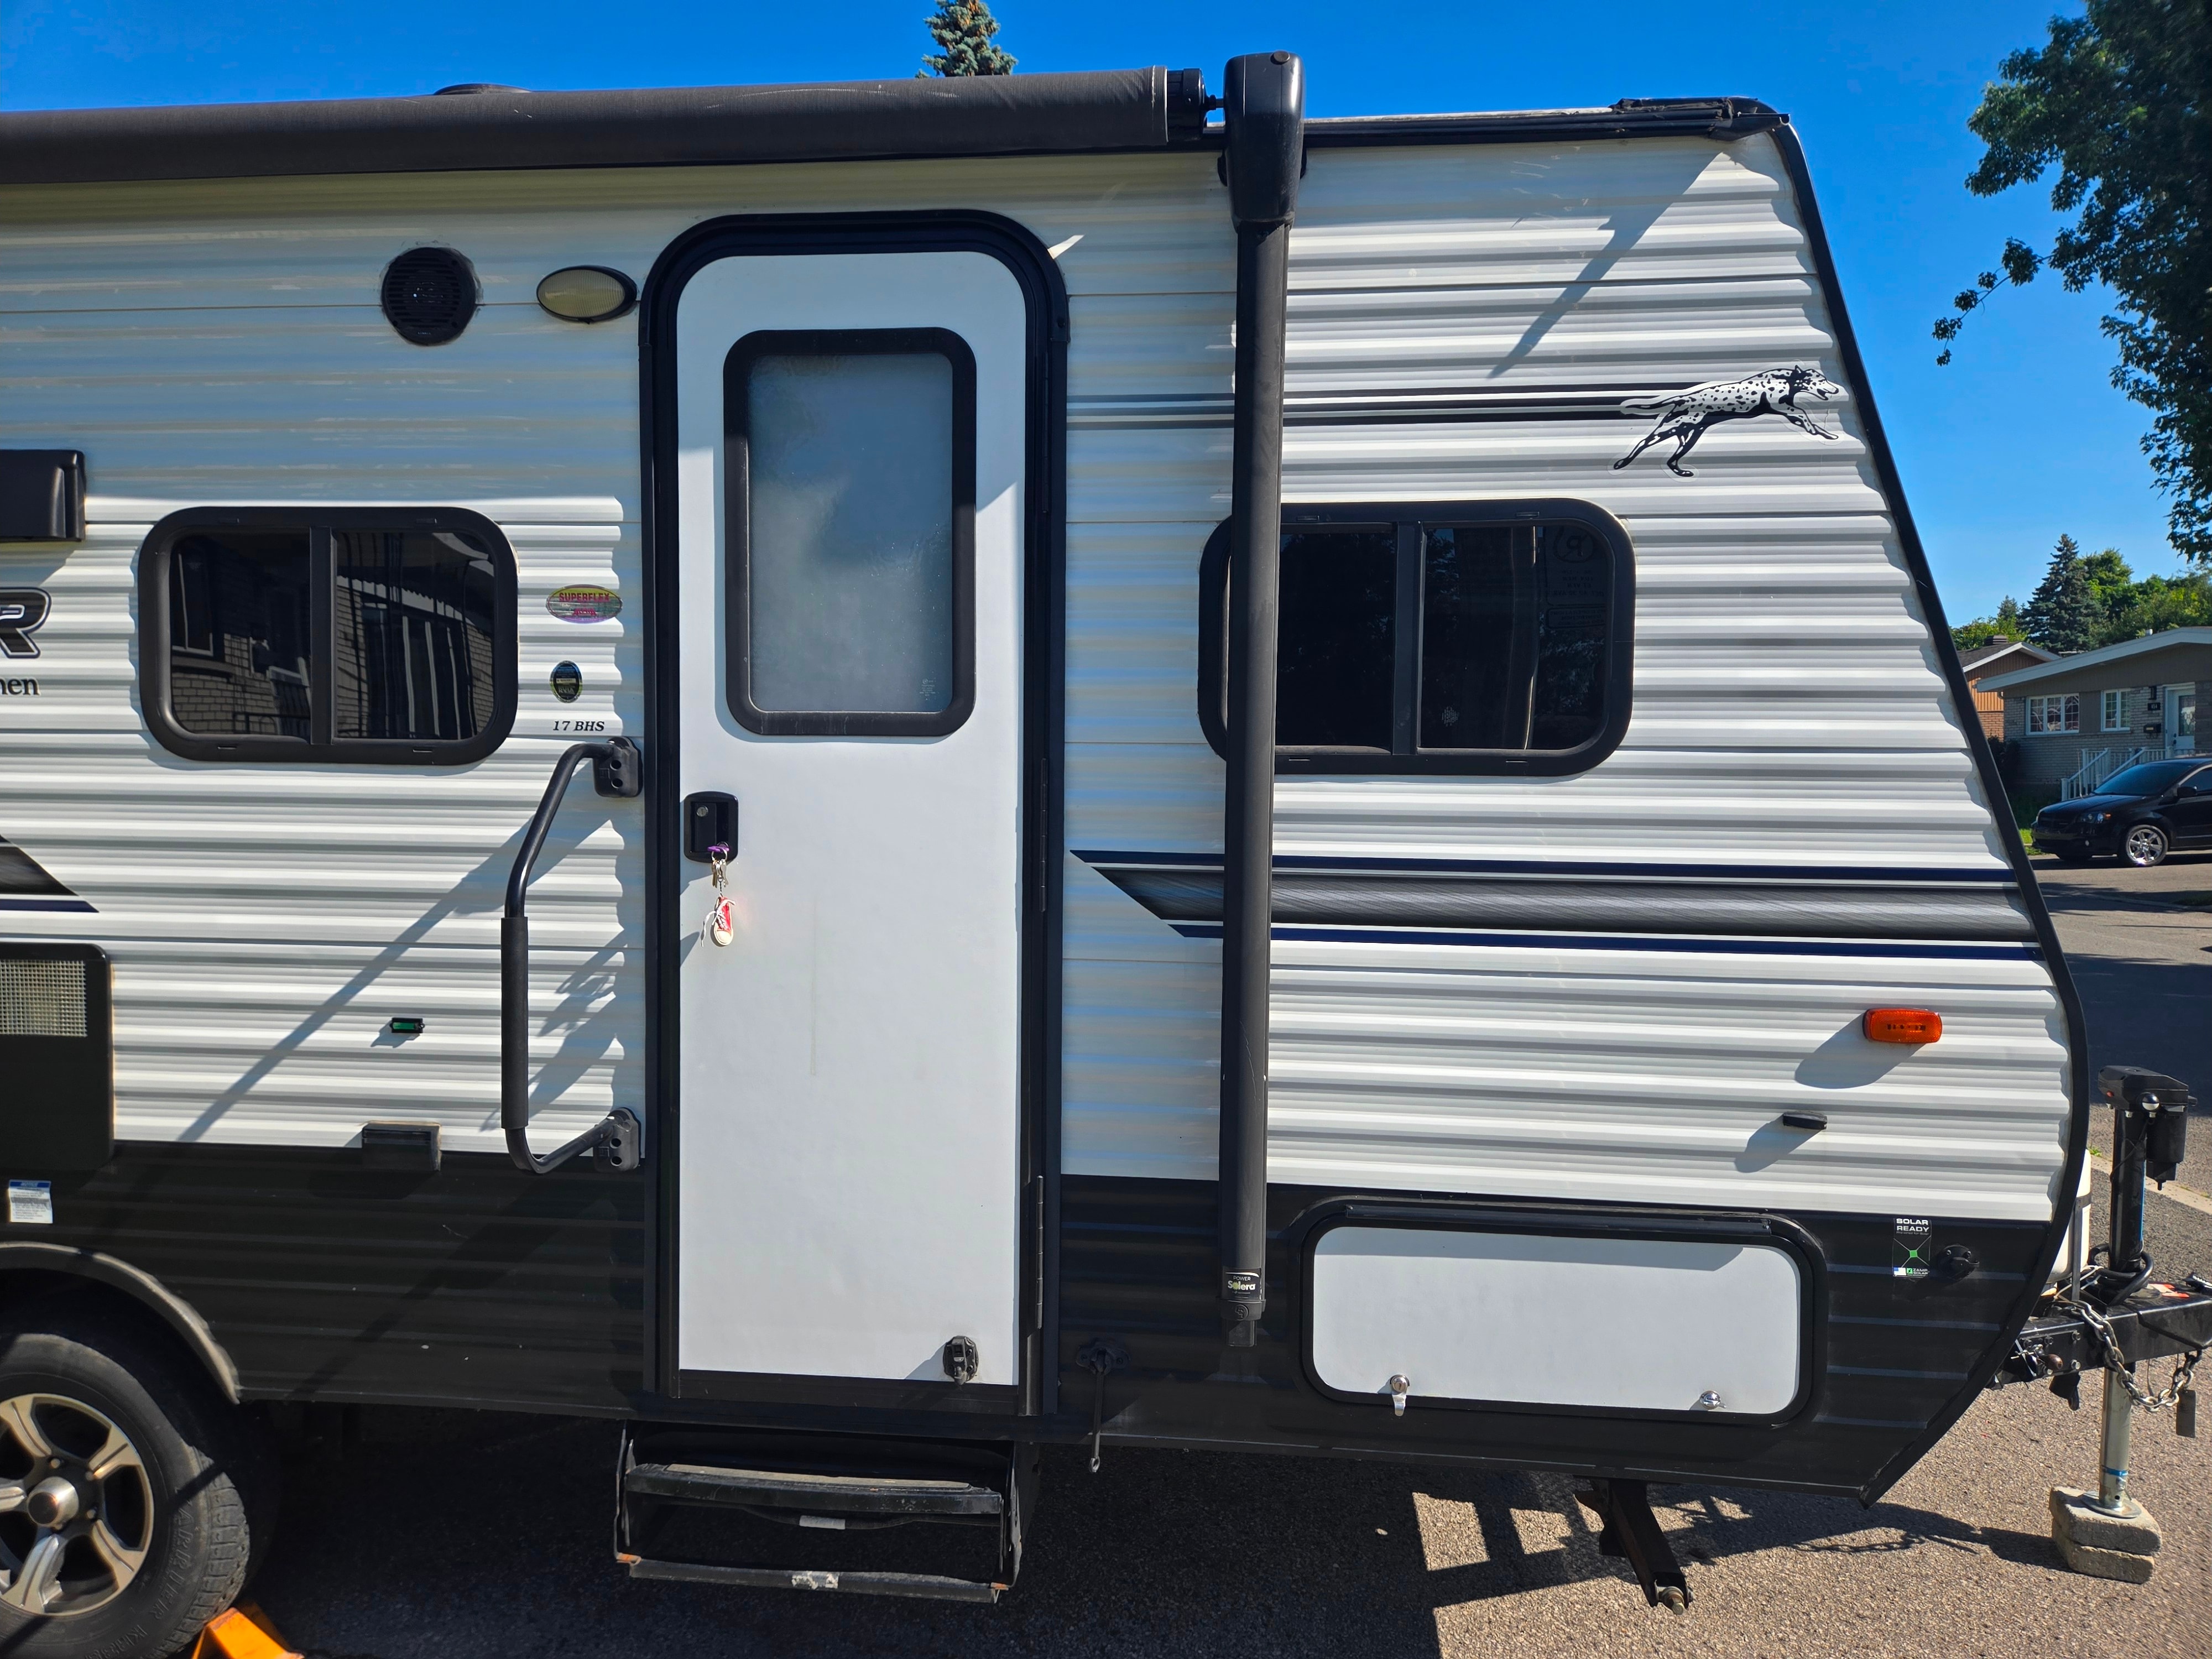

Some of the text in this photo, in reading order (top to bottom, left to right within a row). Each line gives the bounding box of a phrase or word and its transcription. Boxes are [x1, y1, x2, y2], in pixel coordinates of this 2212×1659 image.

[559, 592, 610, 602] SUPERFLEX
[553, 721, 604, 732] 17 BHS
[149, 1486, 194, 1619] ARRIER
